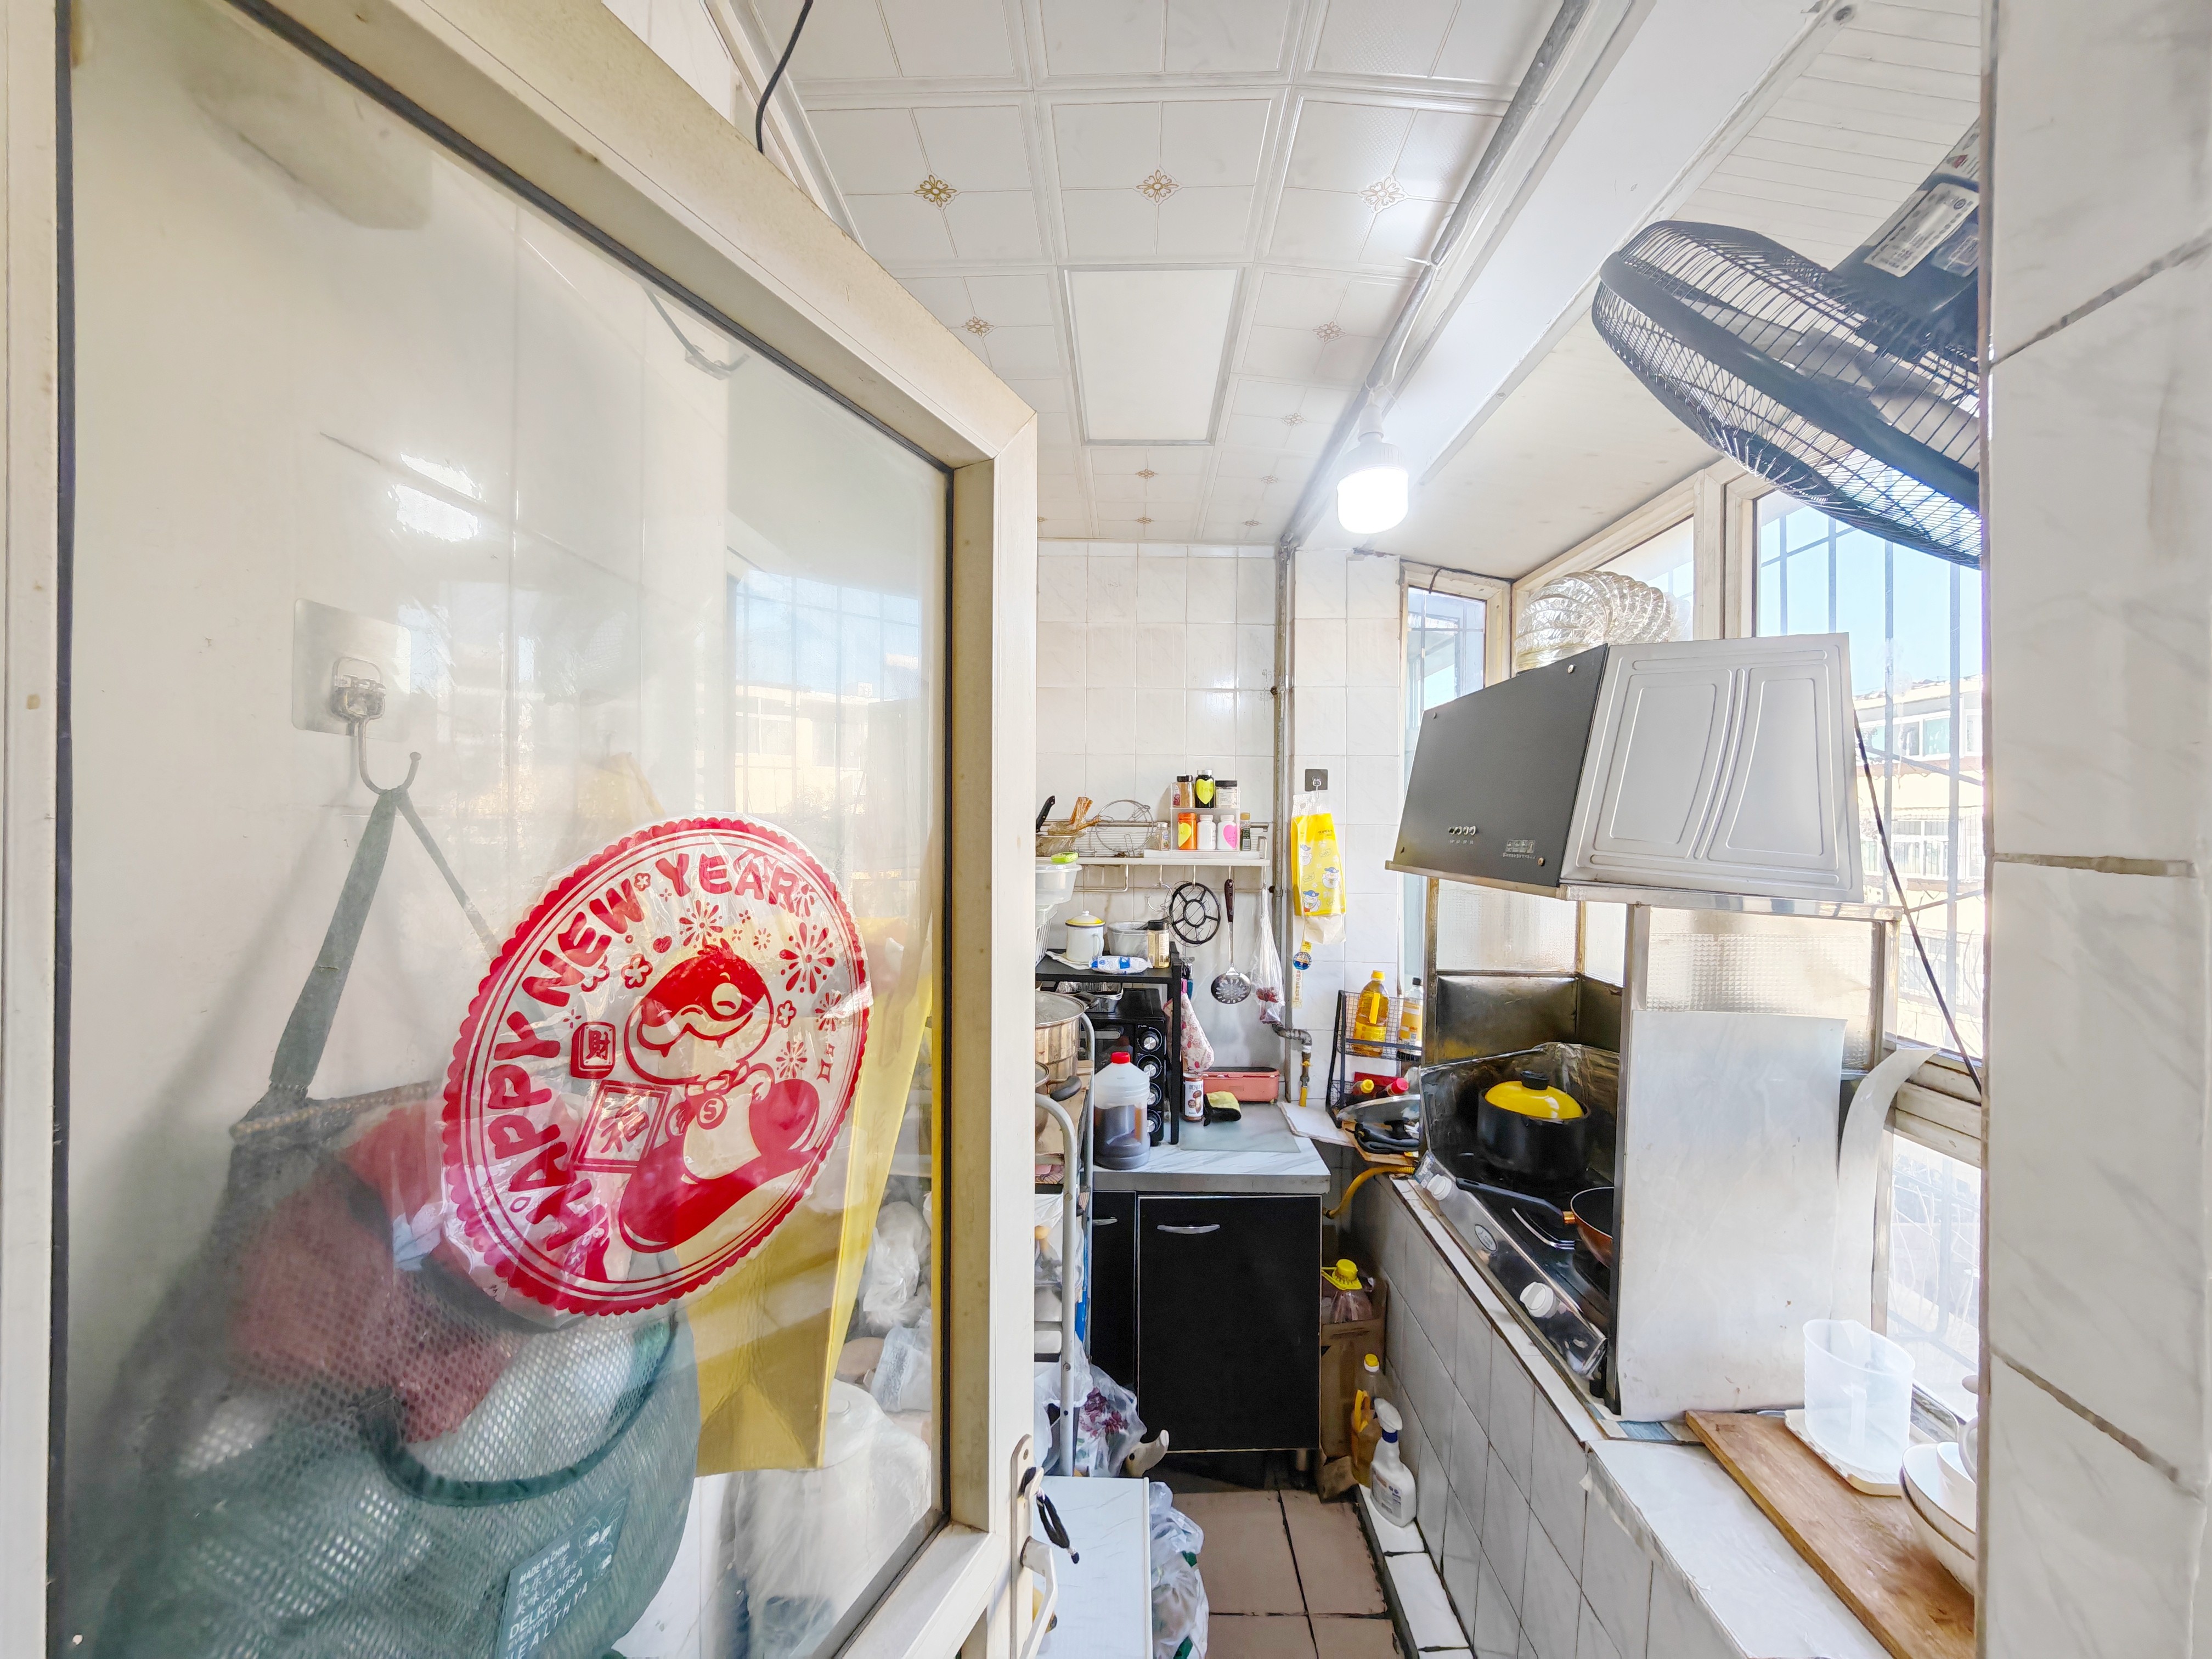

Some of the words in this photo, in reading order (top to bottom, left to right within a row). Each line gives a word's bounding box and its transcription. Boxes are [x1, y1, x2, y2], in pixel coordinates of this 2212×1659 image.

[654, 853, 797, 913] YEAR
[522, 877, 644, 1007] NEW
[488, 1011, 606, 1251] HAPPY
[599, 1095, 650, 1154] 福
[519, 1561, 541, 1585] MADE
[541, 1555, 550, 1570] IN
